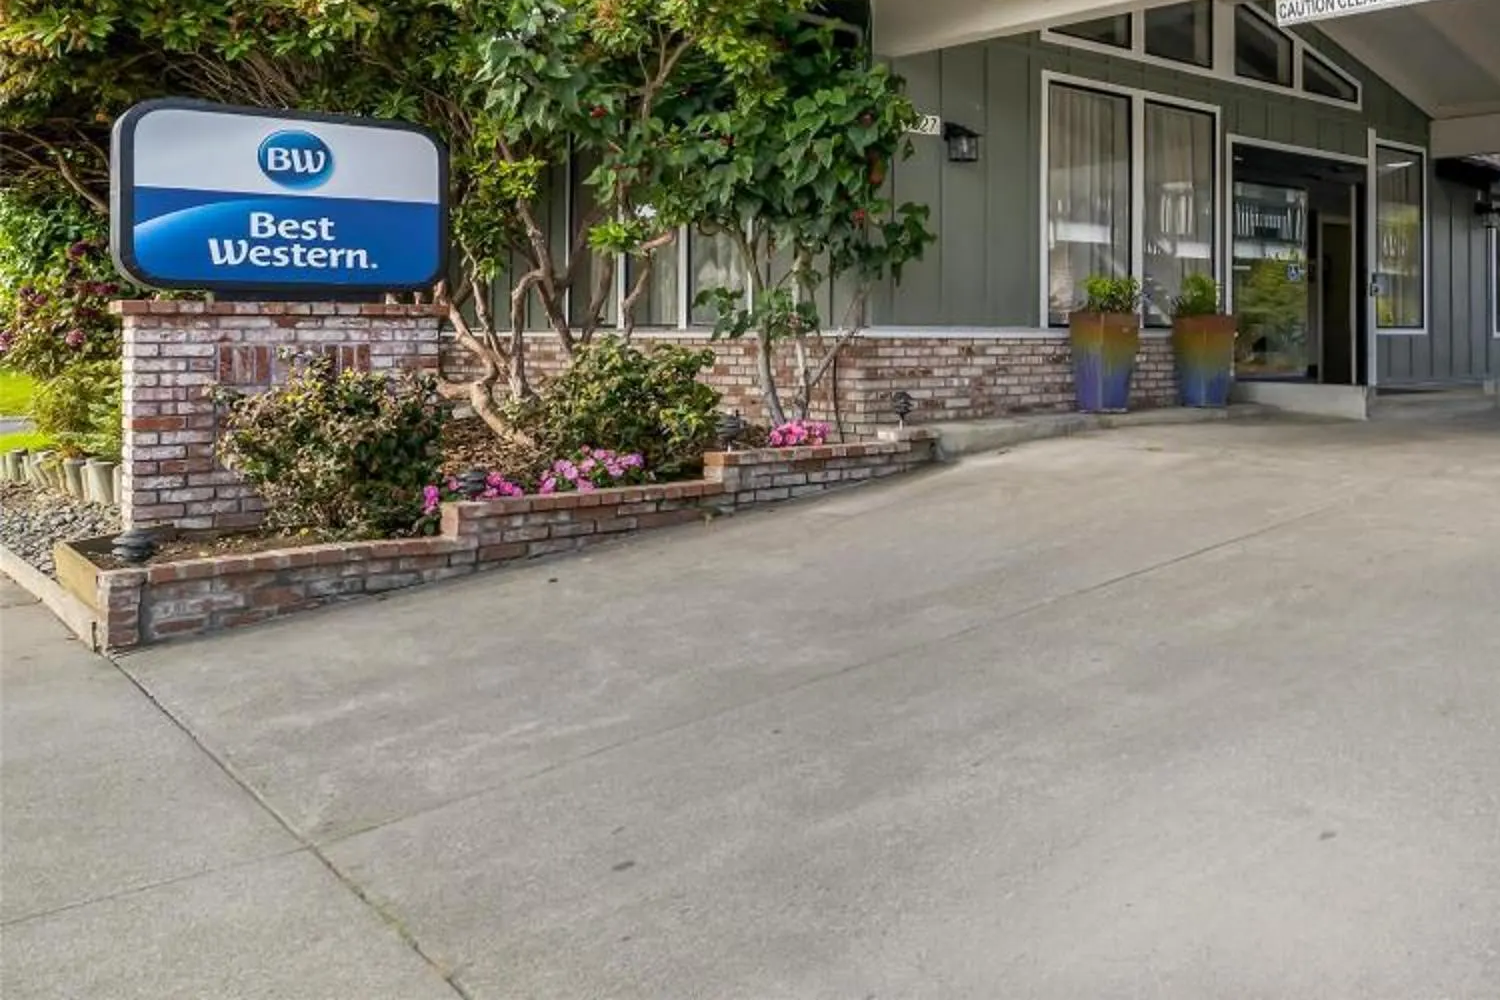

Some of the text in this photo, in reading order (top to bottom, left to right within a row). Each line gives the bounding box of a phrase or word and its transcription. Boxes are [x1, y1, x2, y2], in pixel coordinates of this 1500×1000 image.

[267, 147, 326, 174] BW
[250, 211, 336, 241] Best
[208, 237, 379, 269] Western.
